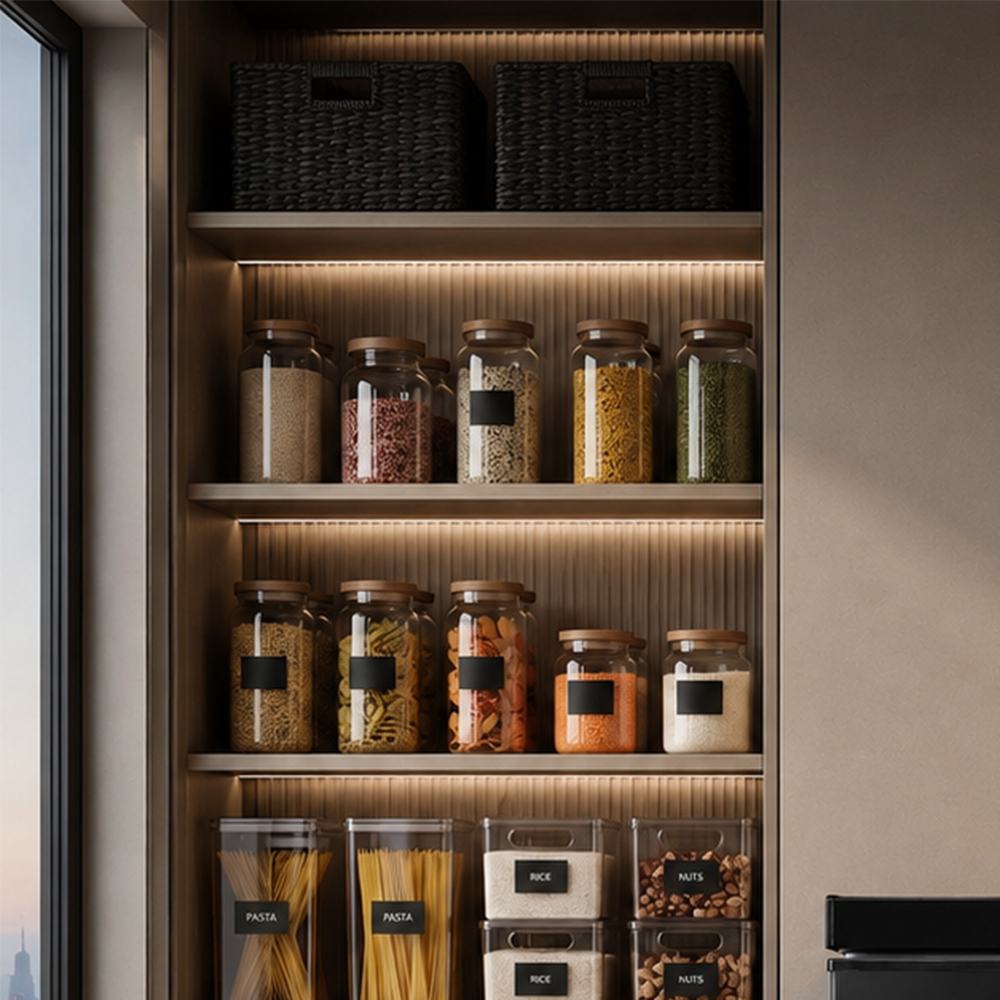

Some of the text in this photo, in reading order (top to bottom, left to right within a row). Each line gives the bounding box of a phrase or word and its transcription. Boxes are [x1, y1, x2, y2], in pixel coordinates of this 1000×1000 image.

[530, 872, 551, 882] RICE
[678, 872, 704, 882] NUTS
[246, 912, 277, 922] PASTA
[383, 912, 413, 922] PASTA
[530, 975, 551, 984] RICE
[678, 975, 704, 984] NUTS
